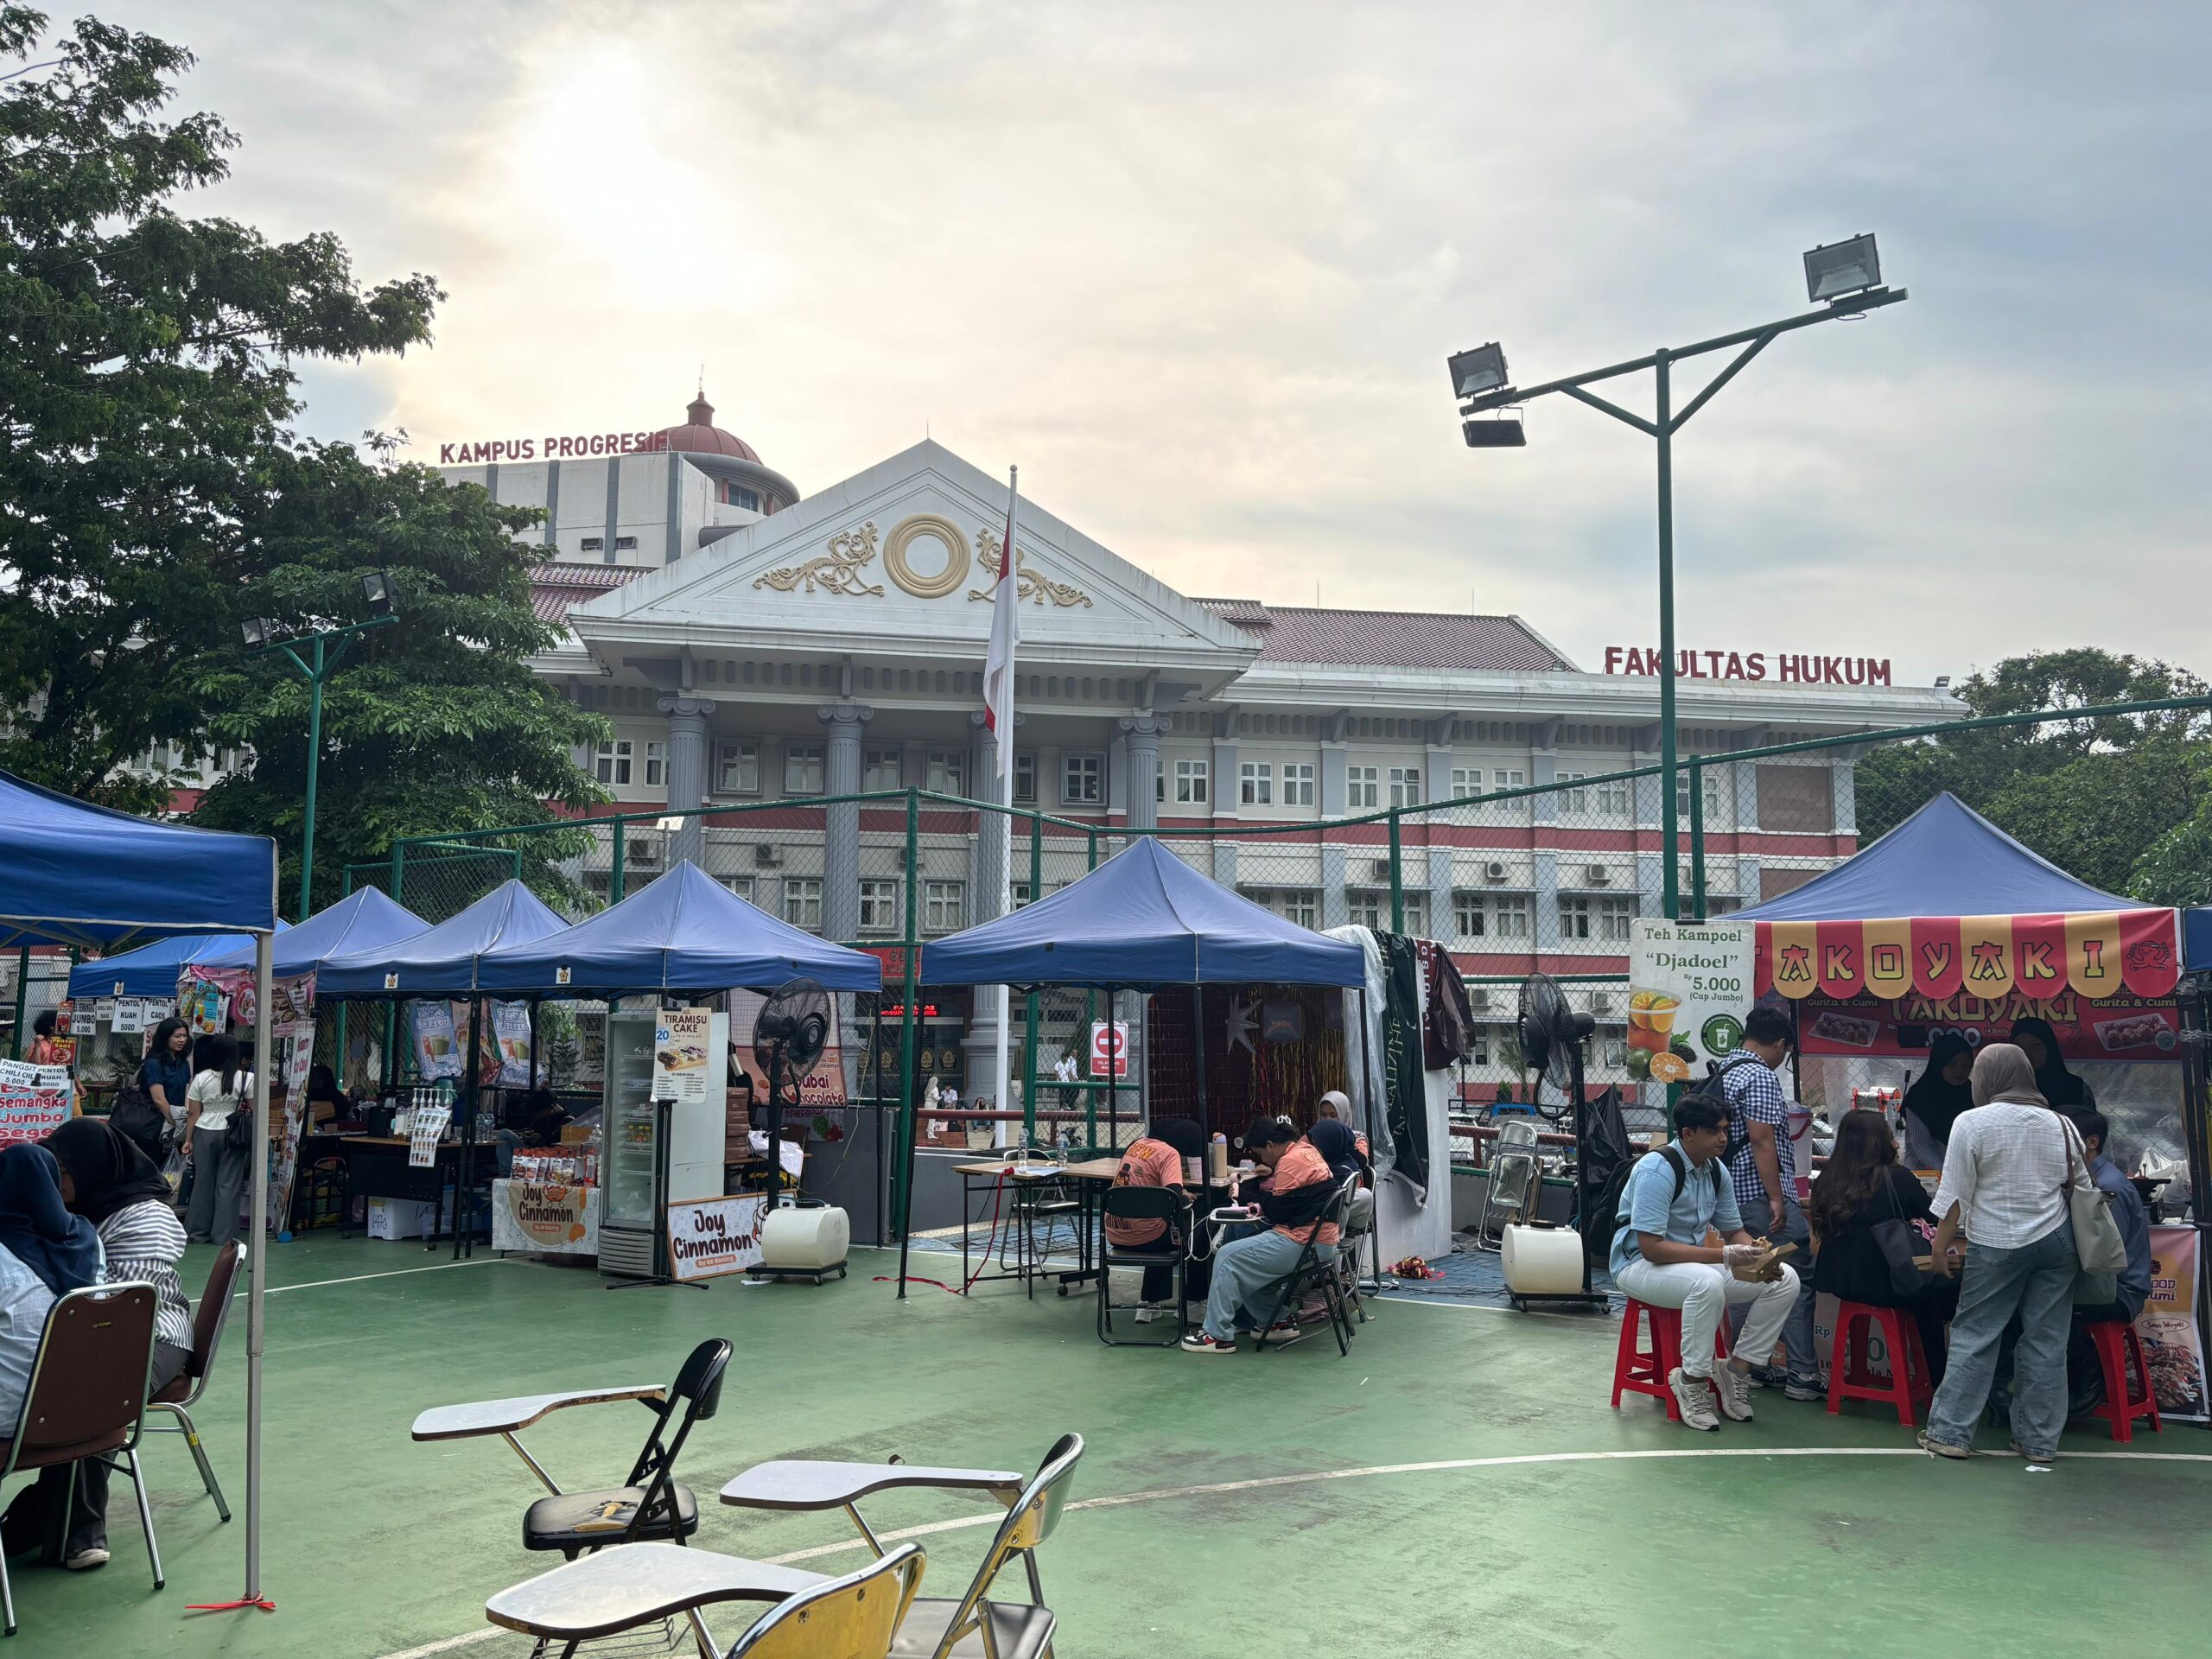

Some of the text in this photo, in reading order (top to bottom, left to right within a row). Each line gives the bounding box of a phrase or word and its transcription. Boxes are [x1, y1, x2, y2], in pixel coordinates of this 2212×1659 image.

[441, 432, 668, 463] KAMPUS PROGRESIF
[1605, 646, 1891, 686] FAKULTAS HUKUM
[1644, 928, 1742, 944] Teh Kampoel
[1755, 940, 2104, 982] AKOYAKI
[1693, 976, 1740, 992] 5.000
[149, 999, 168, 1007] PENTOL
[1689, 992, 1744, 1002] (Cup Jumbo)
[2092, 999, 2131, 1007] Gurita
[2146, 998, 2177, 1007] Cumi
[73, 1014, 96, 1024] JUMBO
[664, 1014, 707, 1024] TIRAMISU
[673, 1024, 698, 1033] CAKE
[657, 1030, 669, 1040] 20
[0, 1068, 21, 1077] CHILI
[3, 1061, 37, 1072] PANGSIT
[0, 1096, 67, 1109] Semangka
[0, 1112, 64, 1123] Jumbo
[0, 1127, 54, 1140] Sege
[523, 1183, 542, 1207] Joy
[519, 1202, 573, 1223] Cinnamon
[694, 1210, 725, 1237] Joy
[673, 1234, 753, 1259] Cinnamon
[2151, 1280, 2176, 1288] OOD
[2150, 1291, 2176, 1301] umi
[1815, 1325, 1830, 1338] Rp
